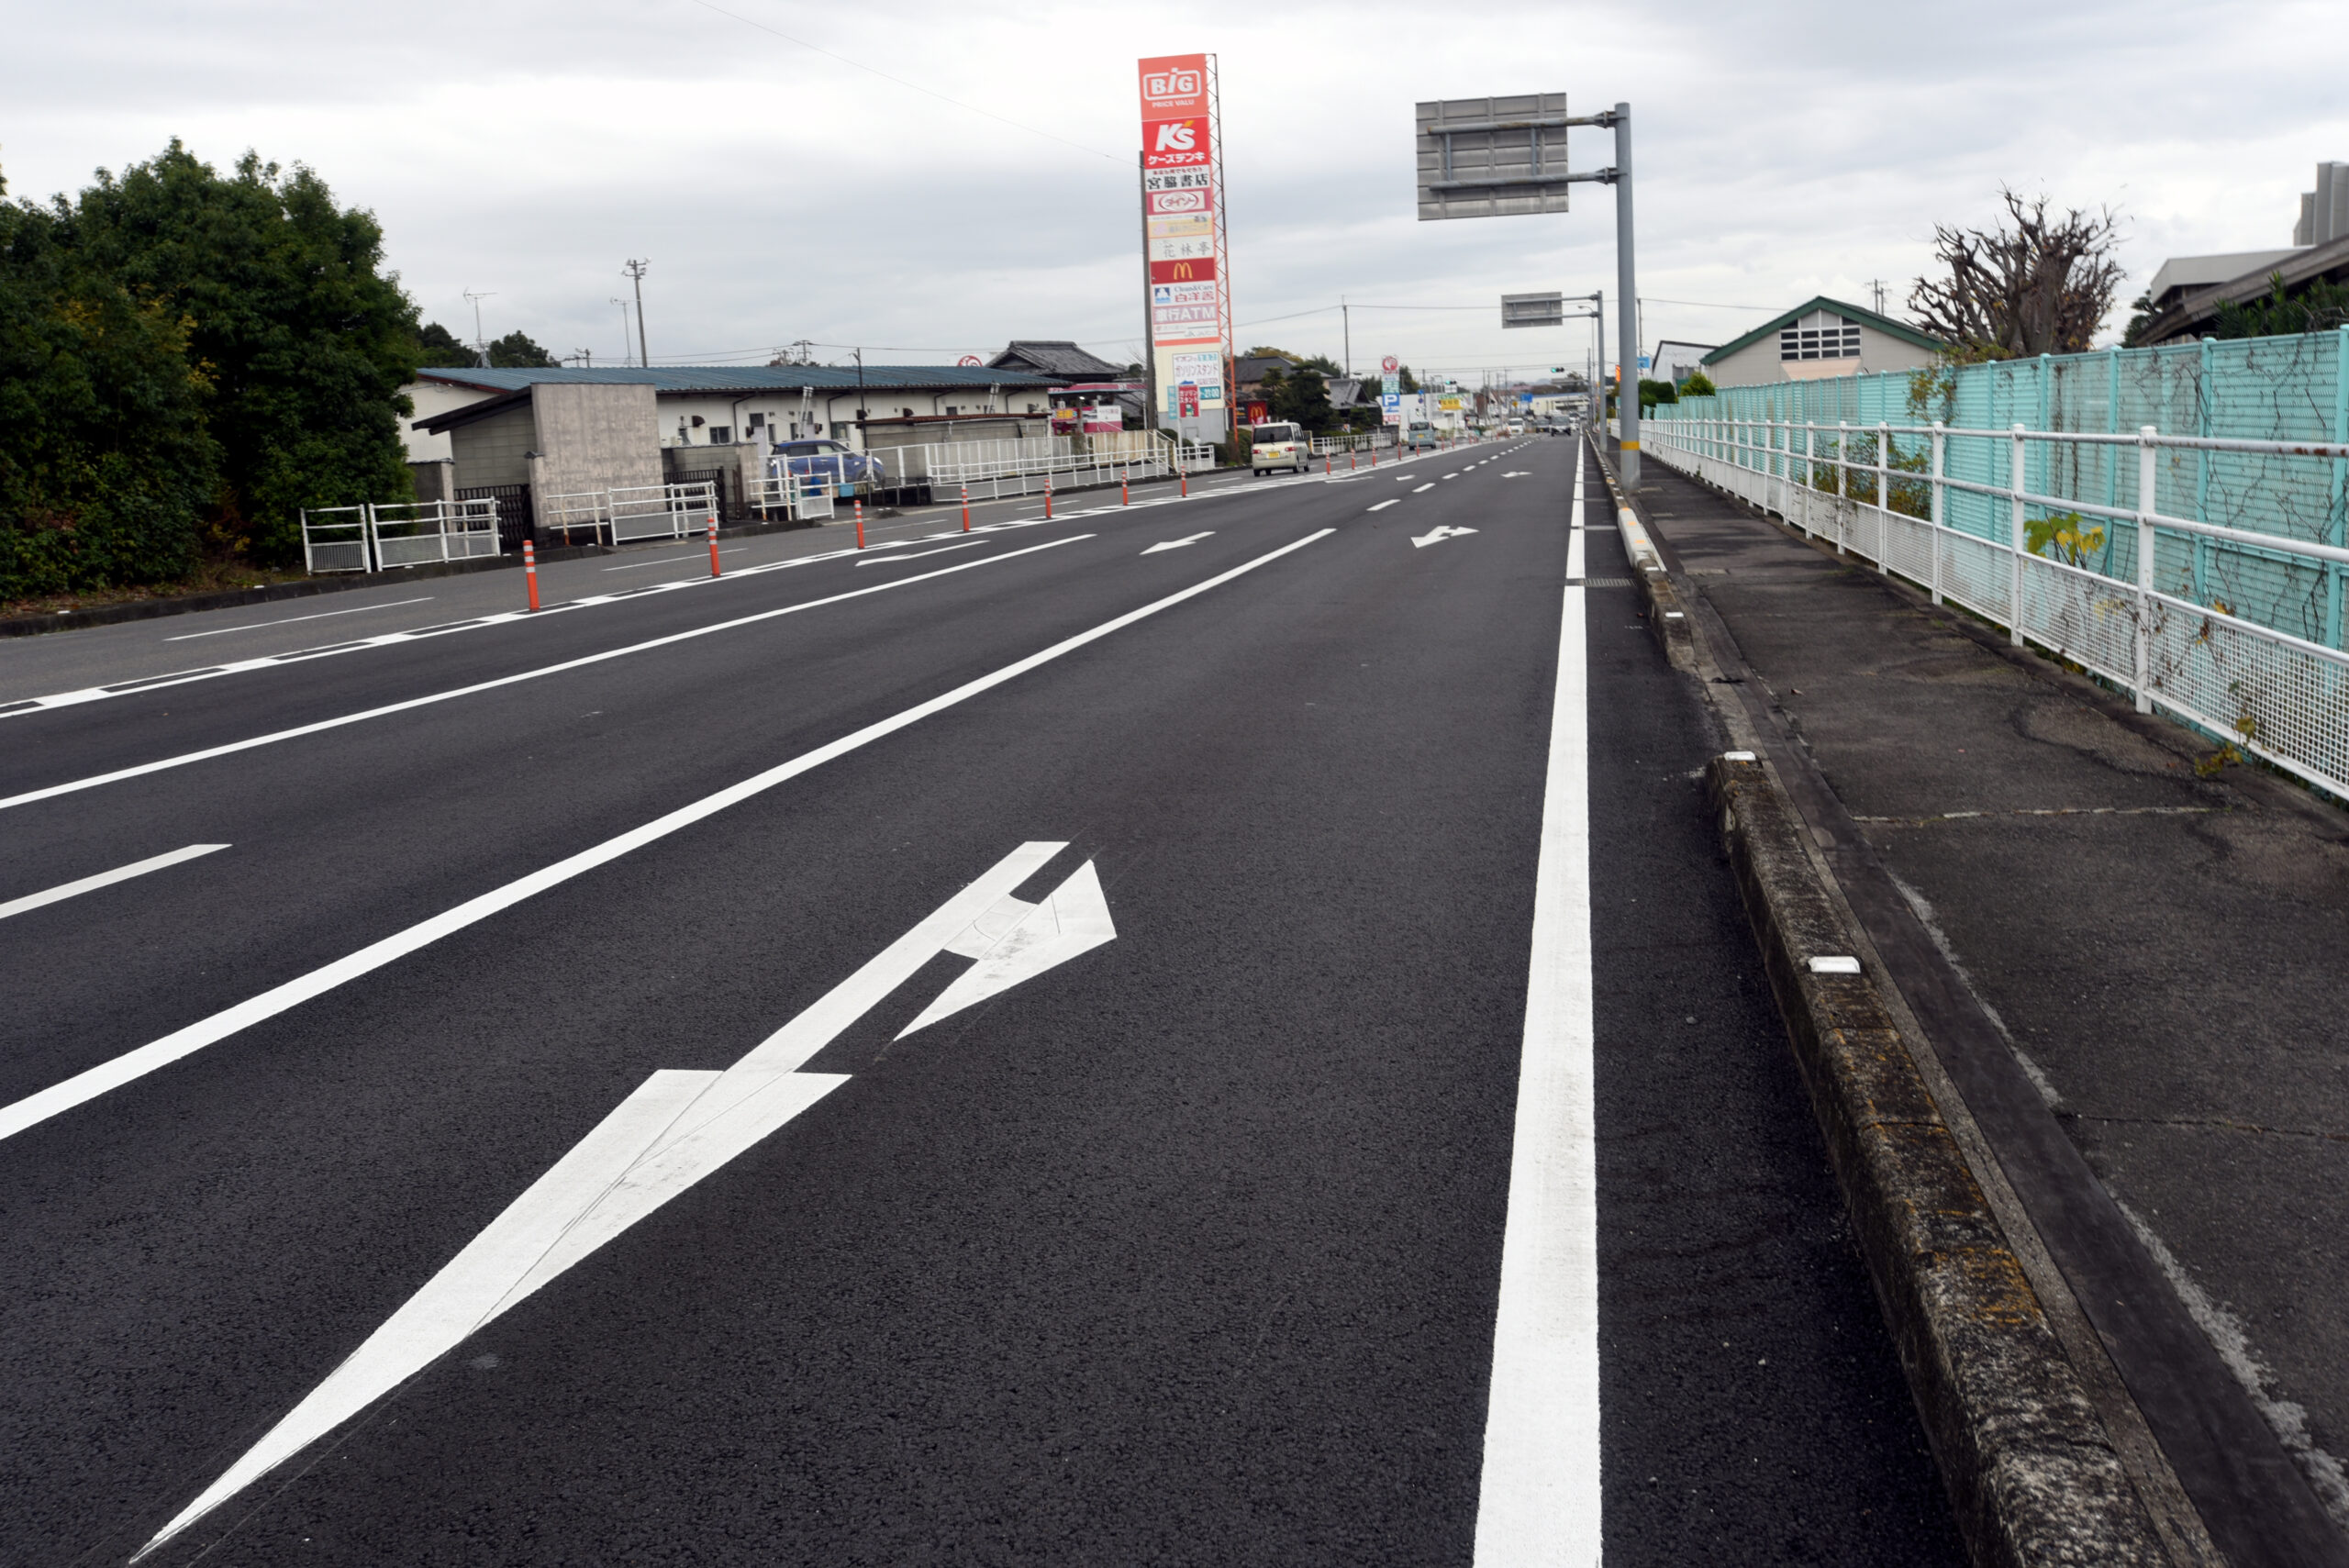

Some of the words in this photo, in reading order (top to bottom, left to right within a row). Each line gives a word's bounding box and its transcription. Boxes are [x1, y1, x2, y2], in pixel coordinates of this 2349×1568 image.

[1152, 100, 1174, 108] PRICE
[1174, 98, 1195, 106] VALU
[1148, 151, 1205, 165] ケーズデンキ
[1147, 173, 1208, 190] 宮脇書店
[1155, 306, 1216, 322] 銀行ATM
[1175, 362, 1219, 377] ガソリンスタンド
[1385, 395, 1397, 406] P
